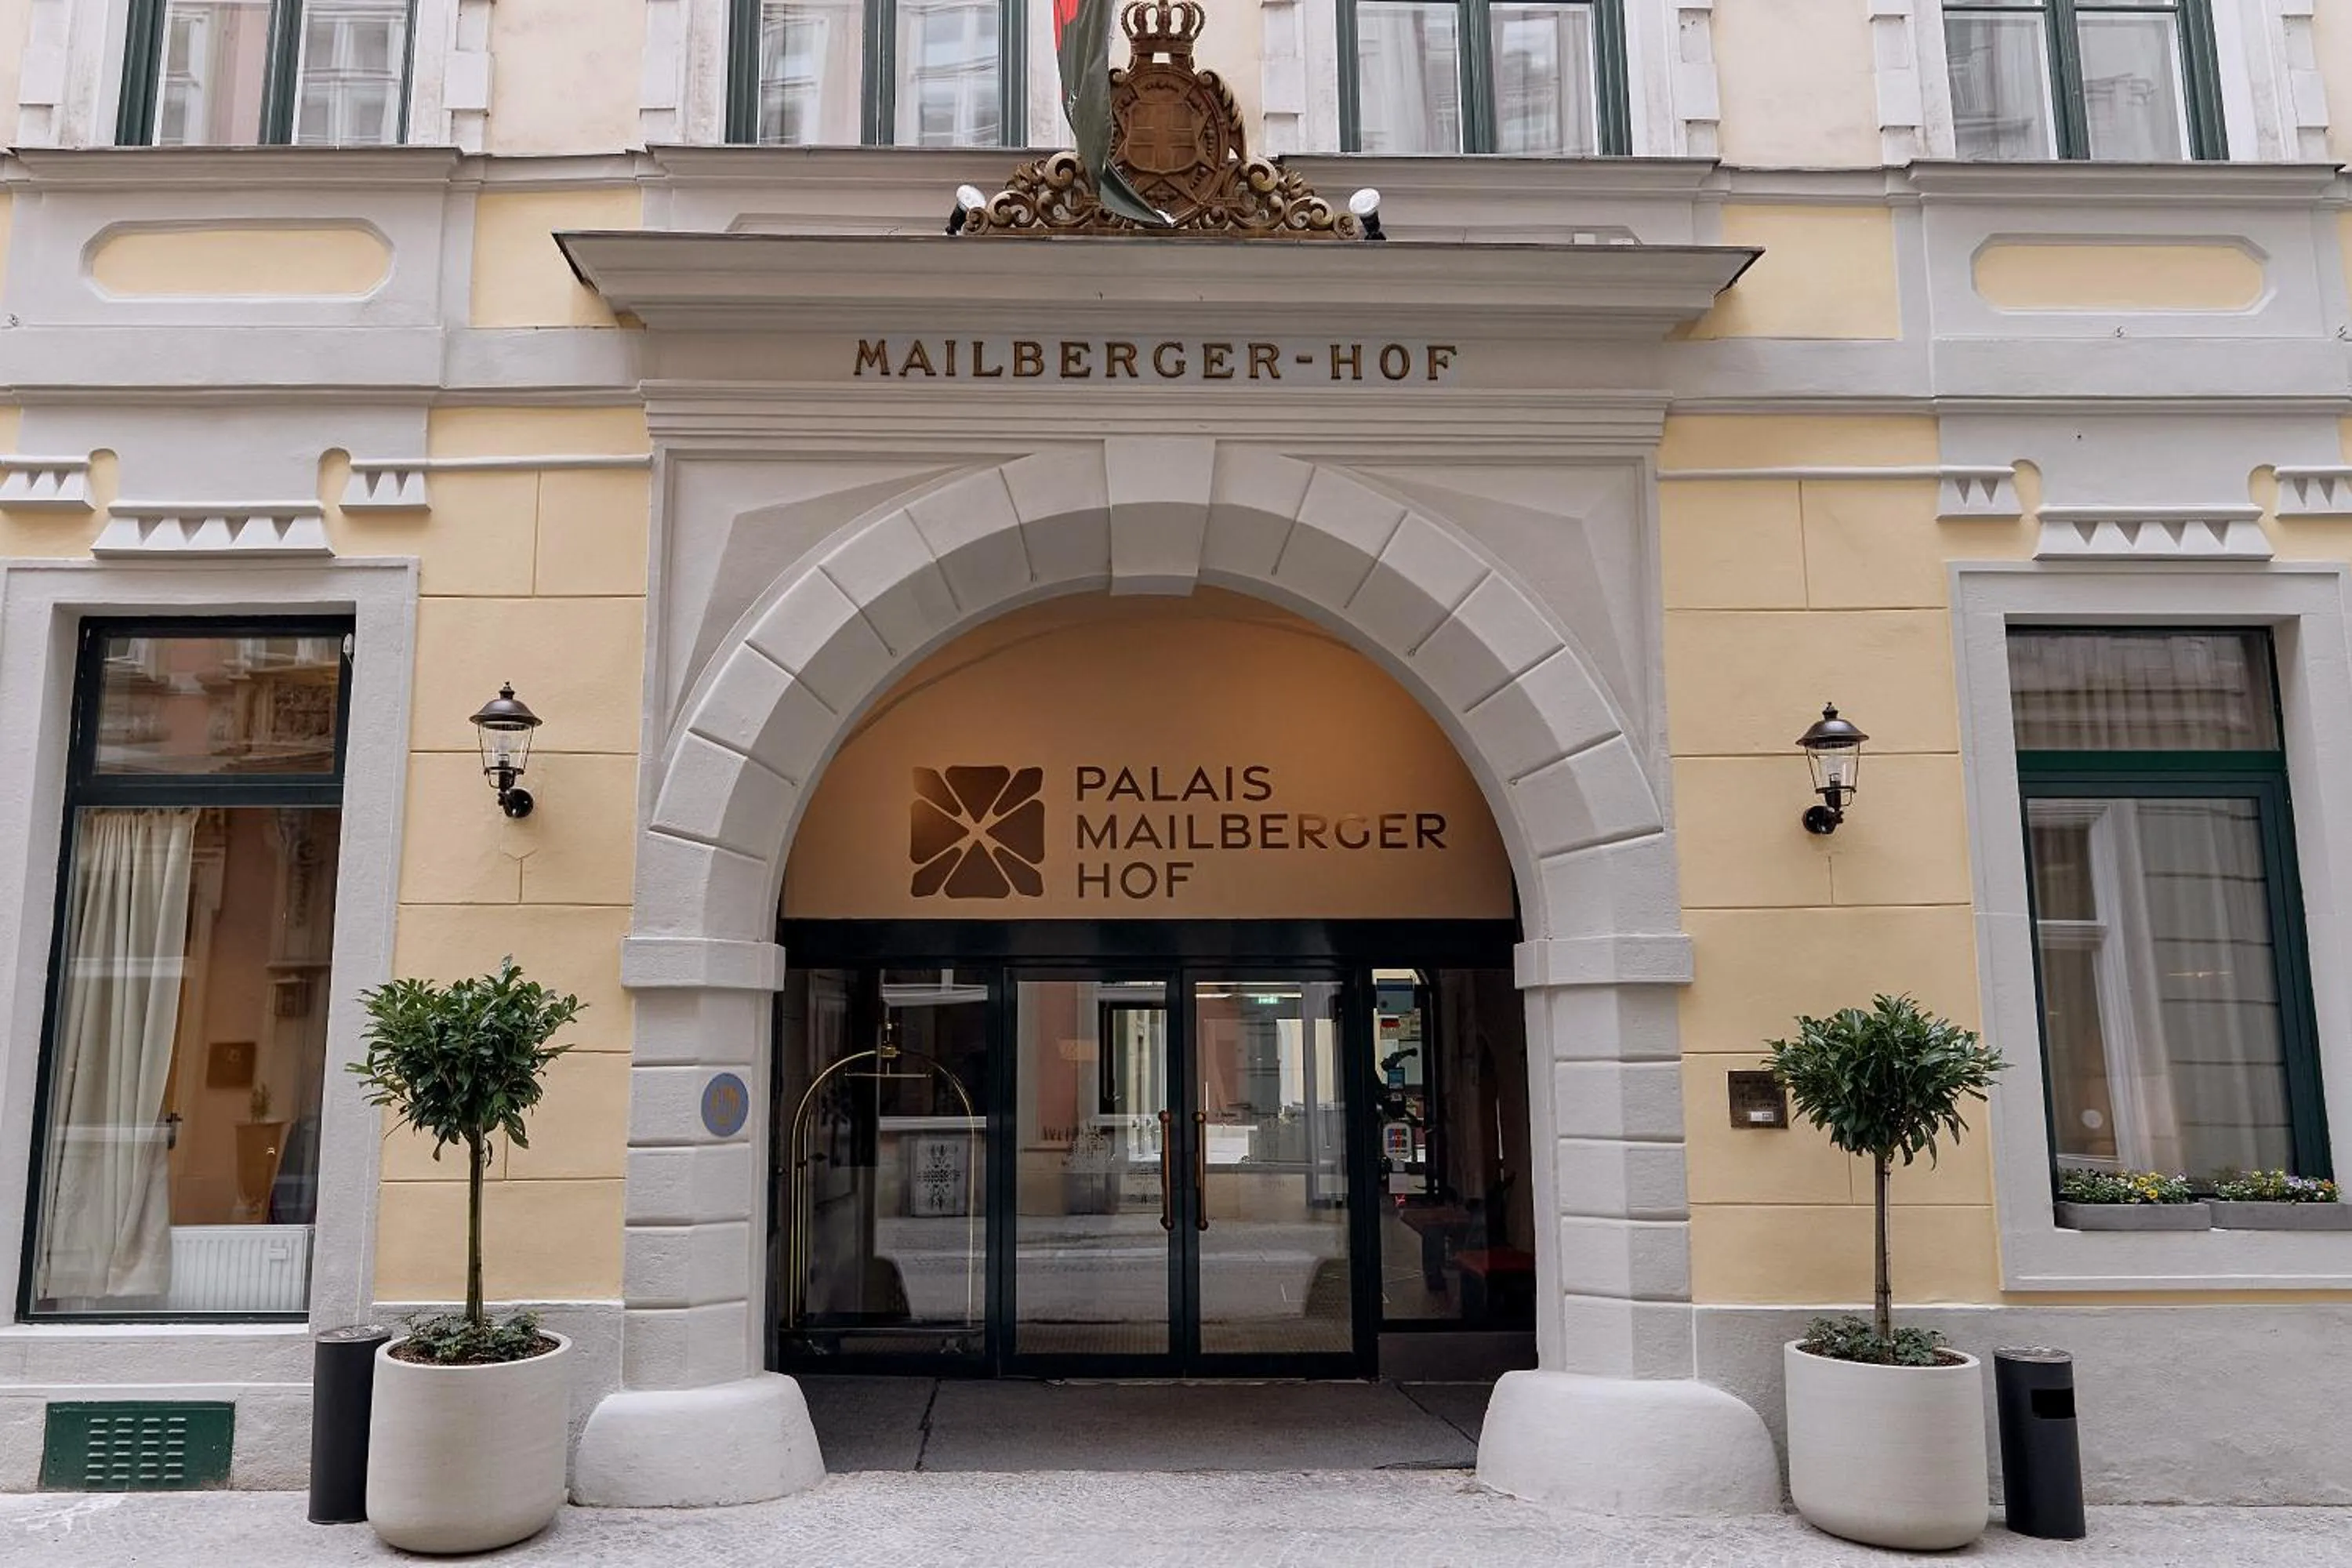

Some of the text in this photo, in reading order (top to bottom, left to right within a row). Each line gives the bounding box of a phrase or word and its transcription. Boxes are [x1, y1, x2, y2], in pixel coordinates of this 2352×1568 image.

[854, 339, 1457, 380] MAILBERGER-HOF
[1076, 766, 1272, 802] PALAIS
[1076, 813, 1447, 850] MAILBERGER
[1076, 862, 1195, 899] HOF
